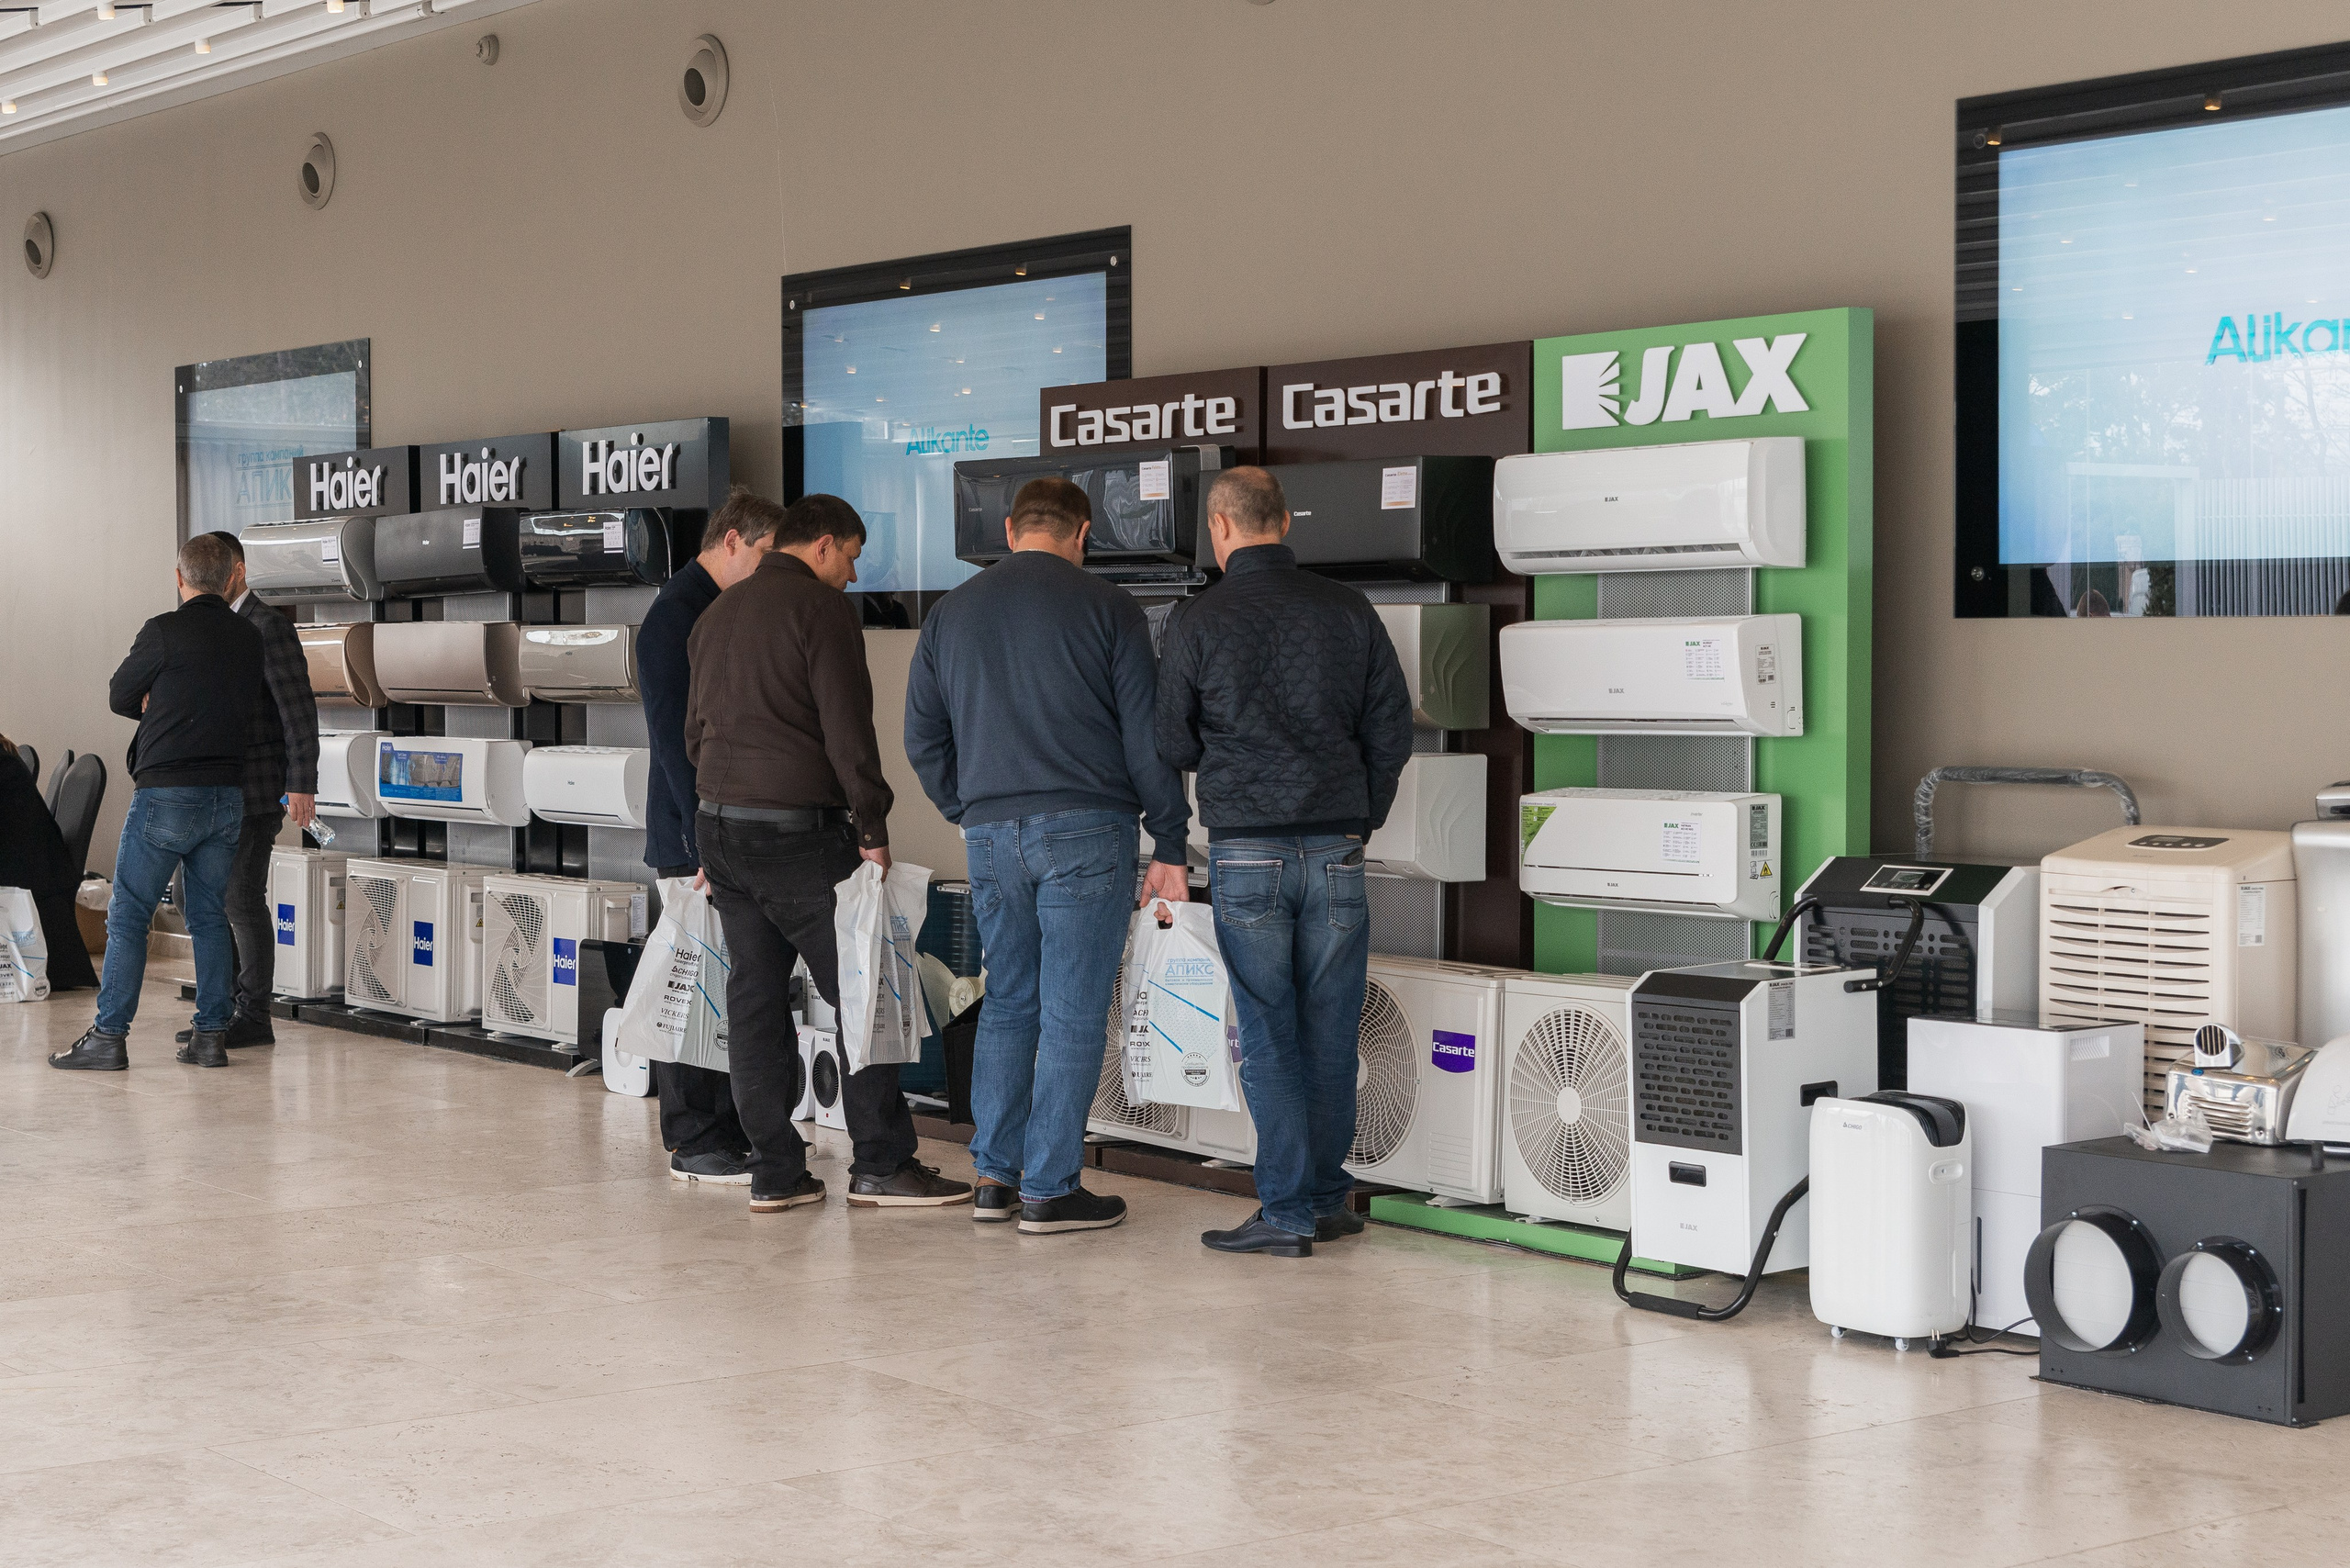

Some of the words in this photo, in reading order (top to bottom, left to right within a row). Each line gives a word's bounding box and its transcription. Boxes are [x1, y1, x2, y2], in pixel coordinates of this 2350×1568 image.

[2204, 311, 2350, 365] Alika
[1623, 332, 1809, 426] JAX
[1282, 371, 1501, 430] Casarte
[1050, 394, 1236, 448] Casarte
[906, 423, 990, 455] Alikante
[582, 432, 673, 496] Haier
[310, 456, 381, 511] Haier
[440, 447, 519, 505] Haier
[237, 467, 293, 504] АПИК
[277, 918, 295, 932] Haier
[413, 936, 433, 952] Haier
[553, 953, 576, 970] Haier
[675, 947, 702, 962] Haier
[677, 968, 699, 978] CHIGO
[1165, 964, 1214, 976] АПИКС
[674, 982, 695, 993] JAX
[664, 994, 692, 1006] ROVEX
[661, 1007, 689, 1019] VICKERS
[1432, 1041, 1475, 1058] Casarte
